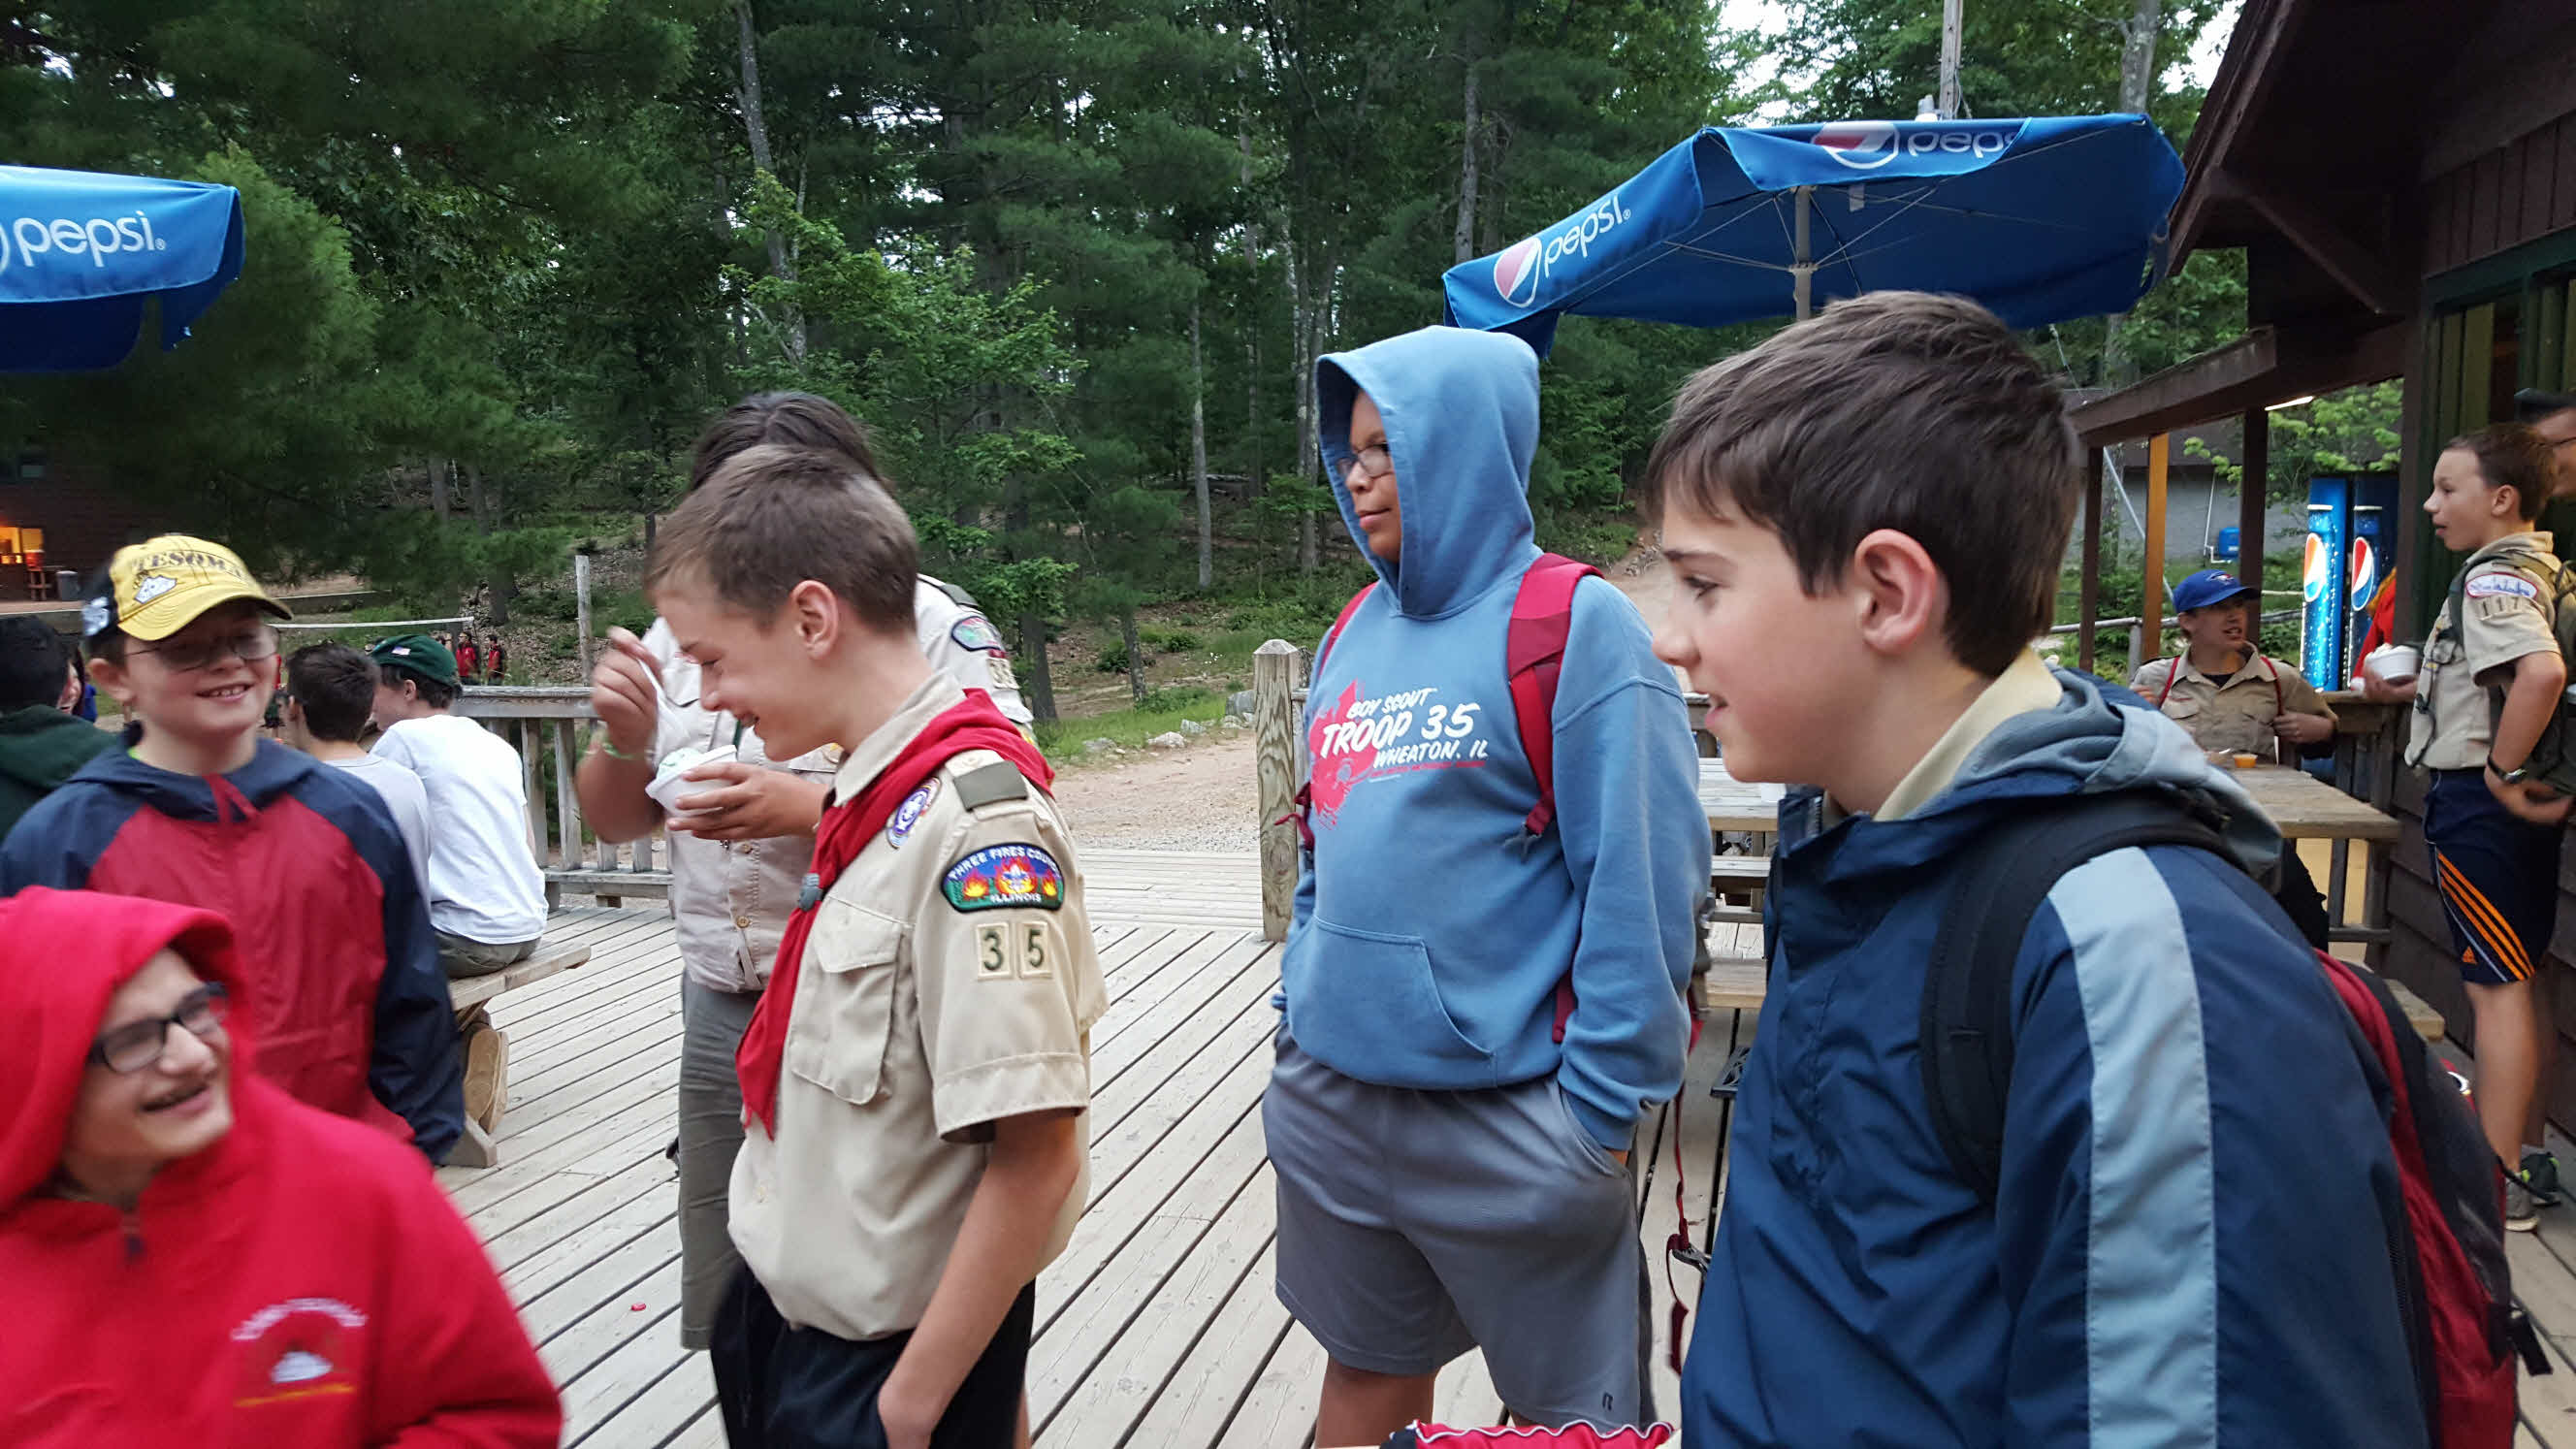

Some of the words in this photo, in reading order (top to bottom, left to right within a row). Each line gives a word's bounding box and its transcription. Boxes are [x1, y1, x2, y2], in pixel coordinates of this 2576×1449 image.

[13, 209, 156, 268] pepsi
[1544, 195, 1624, 279] pepsi
[1346, 697, 1382, 720] BOY
[1381, 688, 1438, 715] SCOUT
[1320, 711, 1413, 759] TROOP
[1421, 702, 1481, 740] 35
[1469, 739, 1489, 759] IL
[948, 852, 988, 881] THREE
[989, 846, 1026, 860] FIRES
[989, 892, 1042, 904] ILLINOIS
